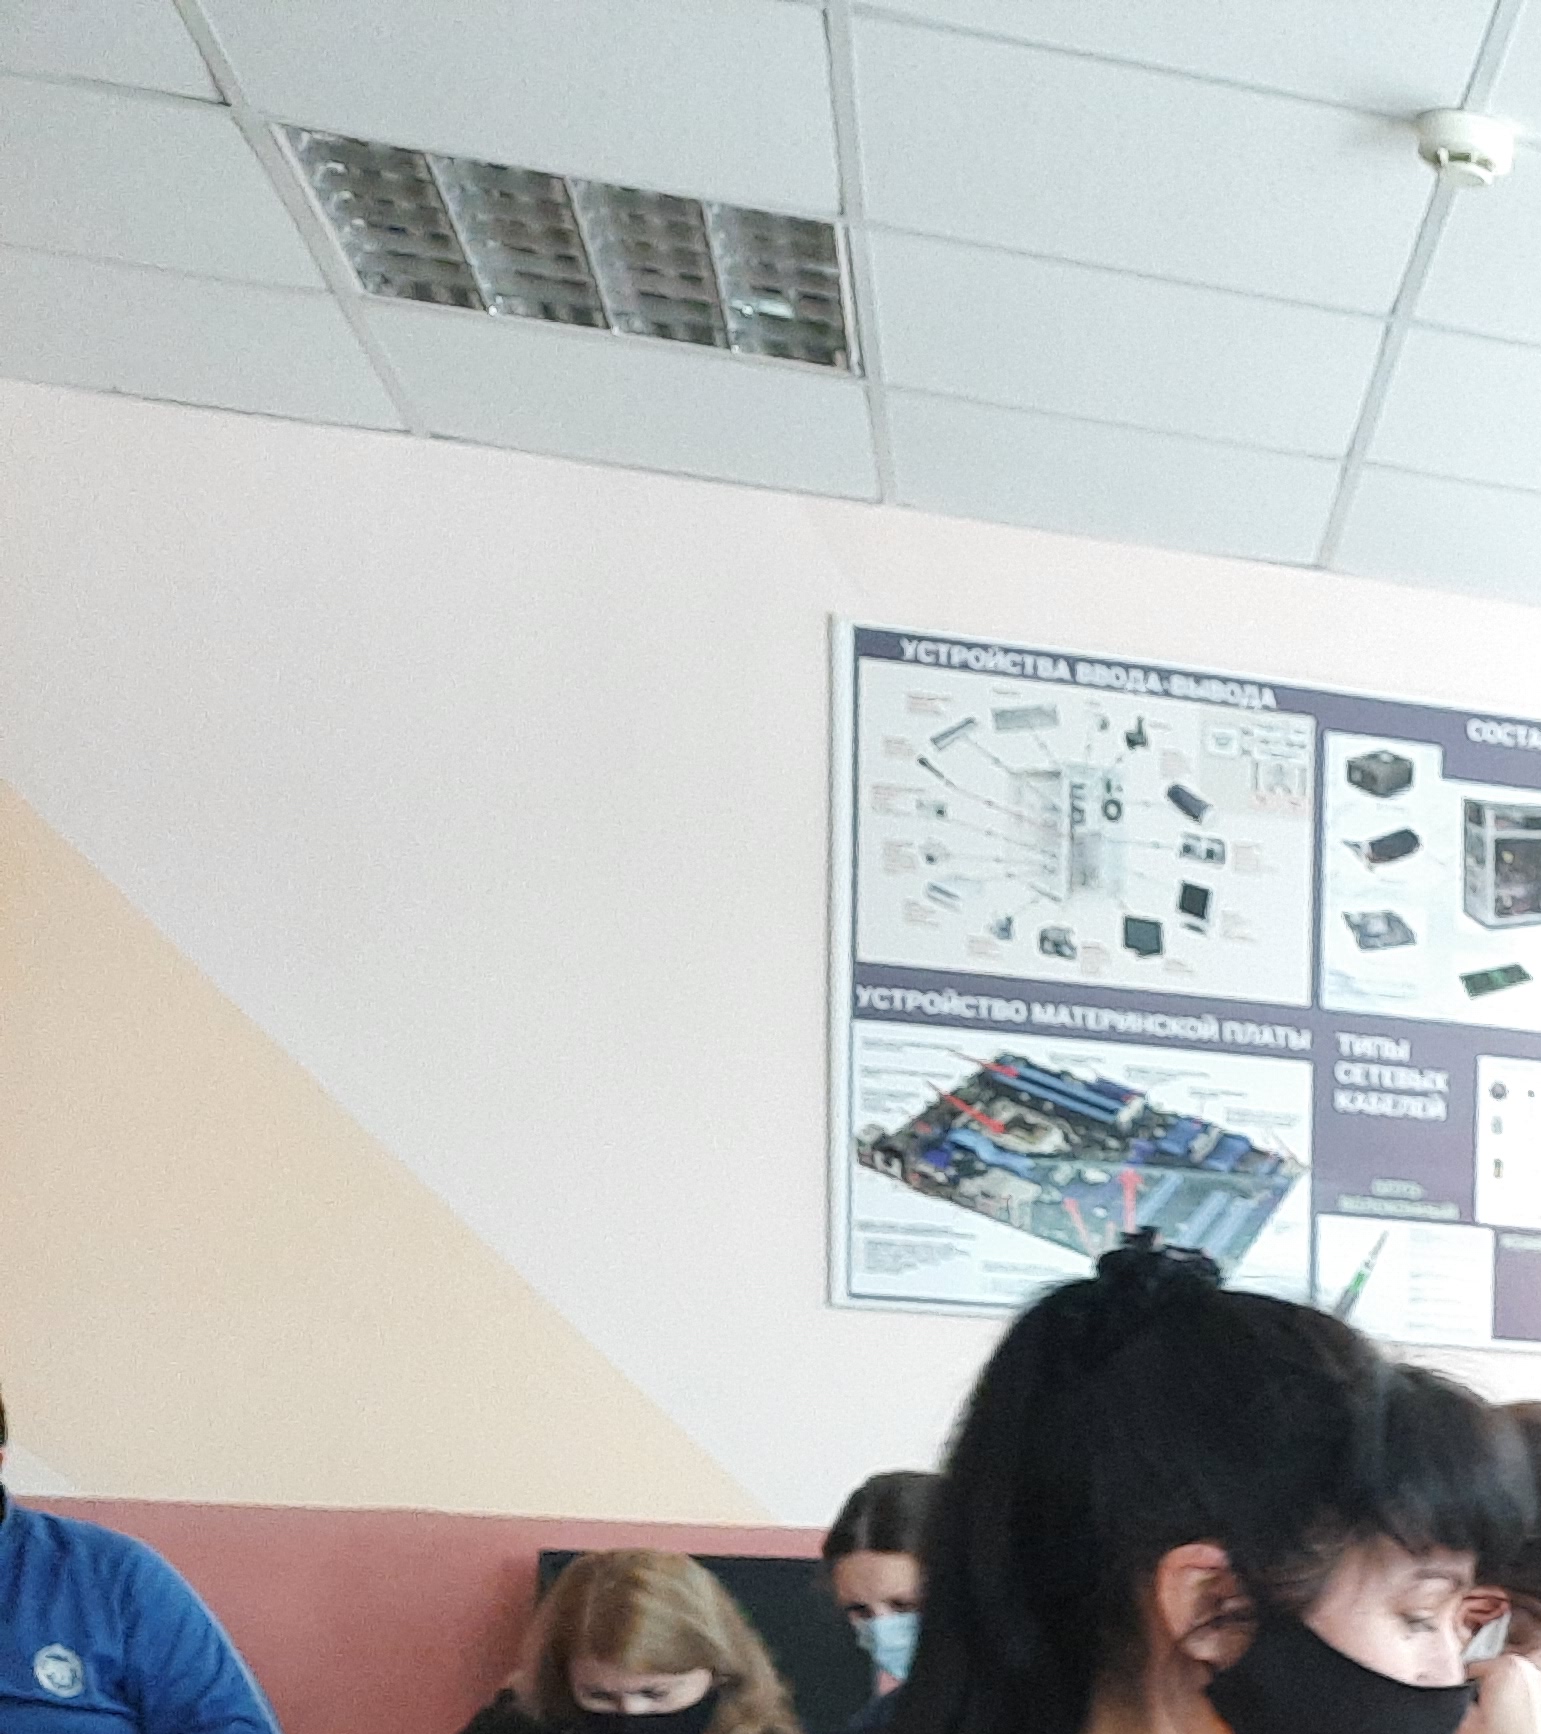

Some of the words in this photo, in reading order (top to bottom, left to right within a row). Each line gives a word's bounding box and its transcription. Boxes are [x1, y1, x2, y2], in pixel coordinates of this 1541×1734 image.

[901, 638, 1072, 681] УСТРОЙСТВА
[857, 984, 1026, 1023] УСТРОЙСТВО
[1032, 1002, 1218, 1042] МАТЕРИНСКОЙ
[1223, 1019, 1313, 1051] ПЛАТЫ
